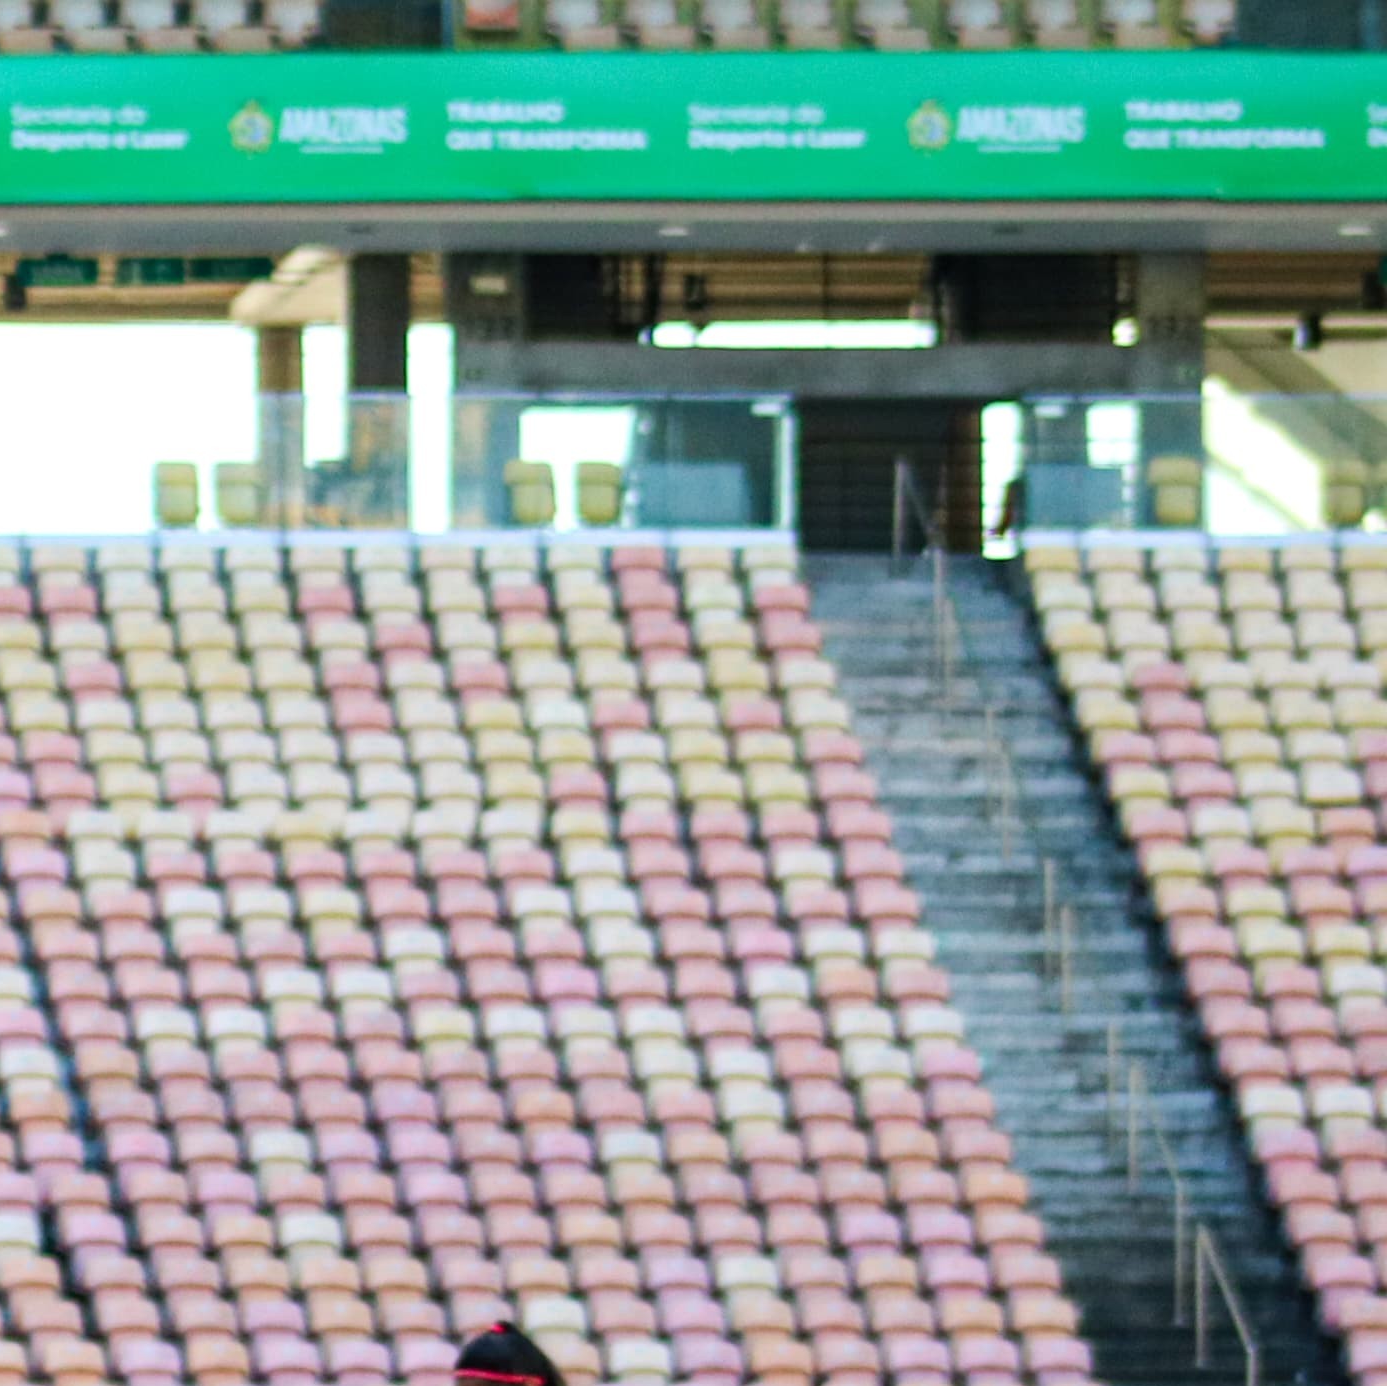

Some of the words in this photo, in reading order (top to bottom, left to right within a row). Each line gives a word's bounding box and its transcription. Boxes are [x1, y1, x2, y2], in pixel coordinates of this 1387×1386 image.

[446, 100, 563, 122] TRABALHO
[1127, 100, 1242, 122] TRABALHO
[279, 106, 407, 143] AMAZONAS
[957, 105, 1087, 143] AMAZONAS
[446, 129, 493, 150] QUE
[498, 129, 648, 150] TRANSFORMA
[1126, 128, 1172, 149] QUE
[1177, 128, 1326, 149] TRANSFORMA
